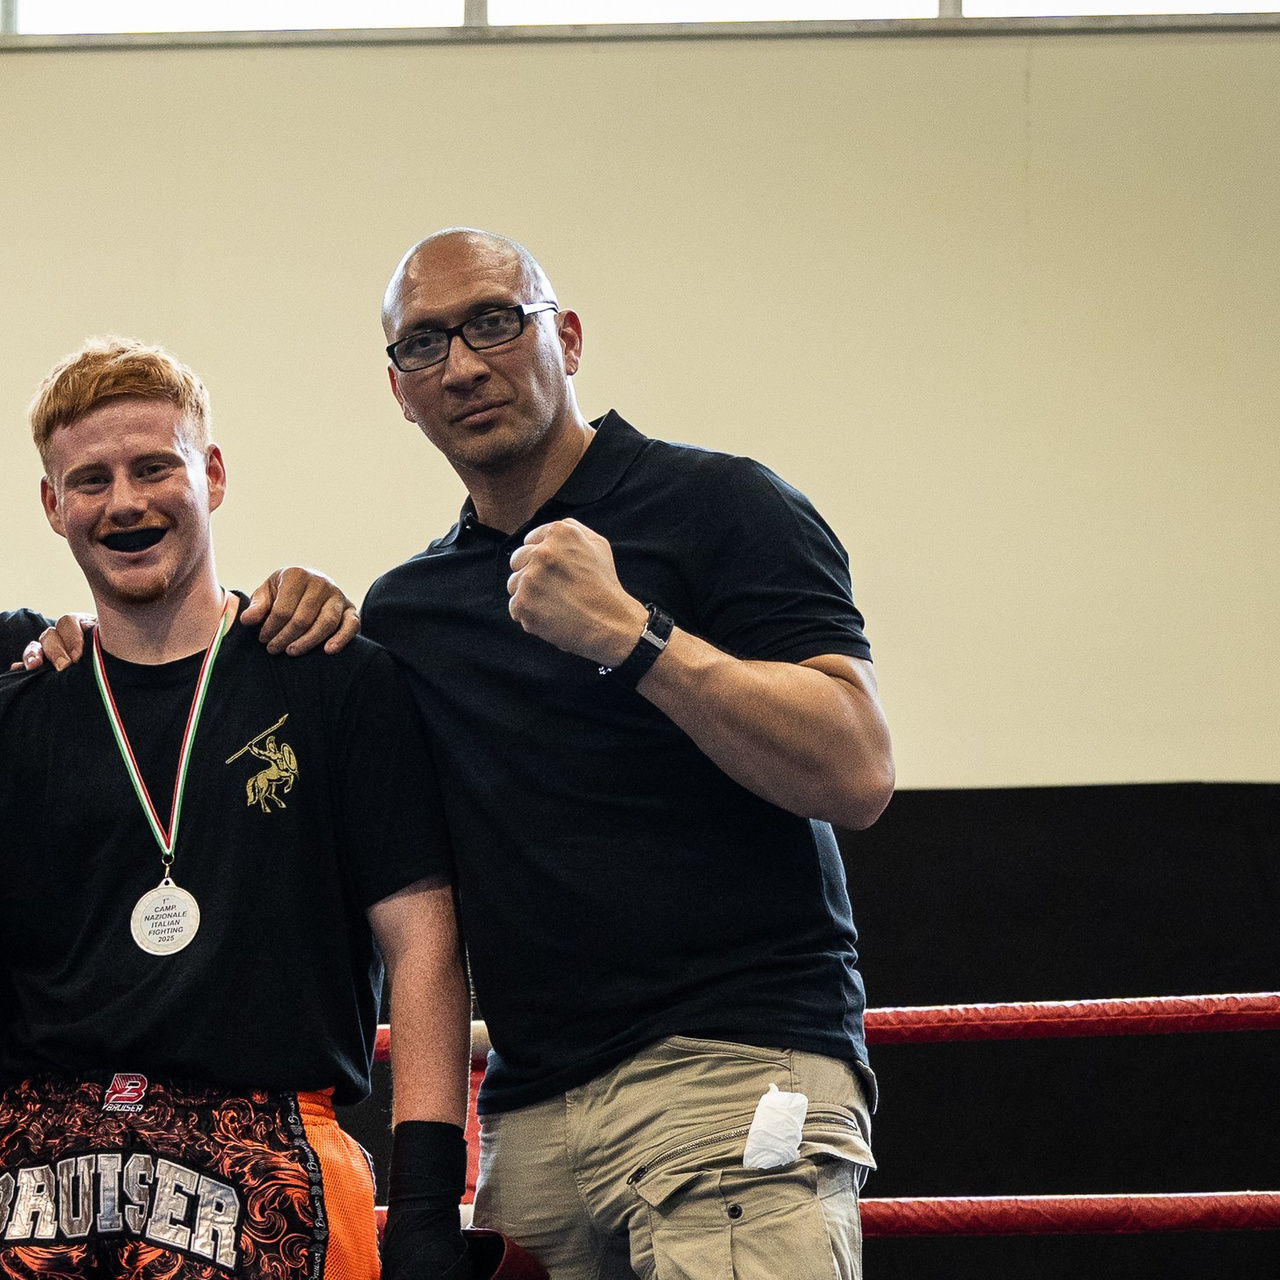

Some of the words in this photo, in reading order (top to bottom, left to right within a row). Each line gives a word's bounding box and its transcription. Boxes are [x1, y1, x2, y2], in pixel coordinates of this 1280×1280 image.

[144, 911, 187, 922] NAZIONALE
[151, 919, 180, 928] ITALIAN
[148, 926, 184, 936] FIGHTING
[158, 935, 175, 943] 2025
